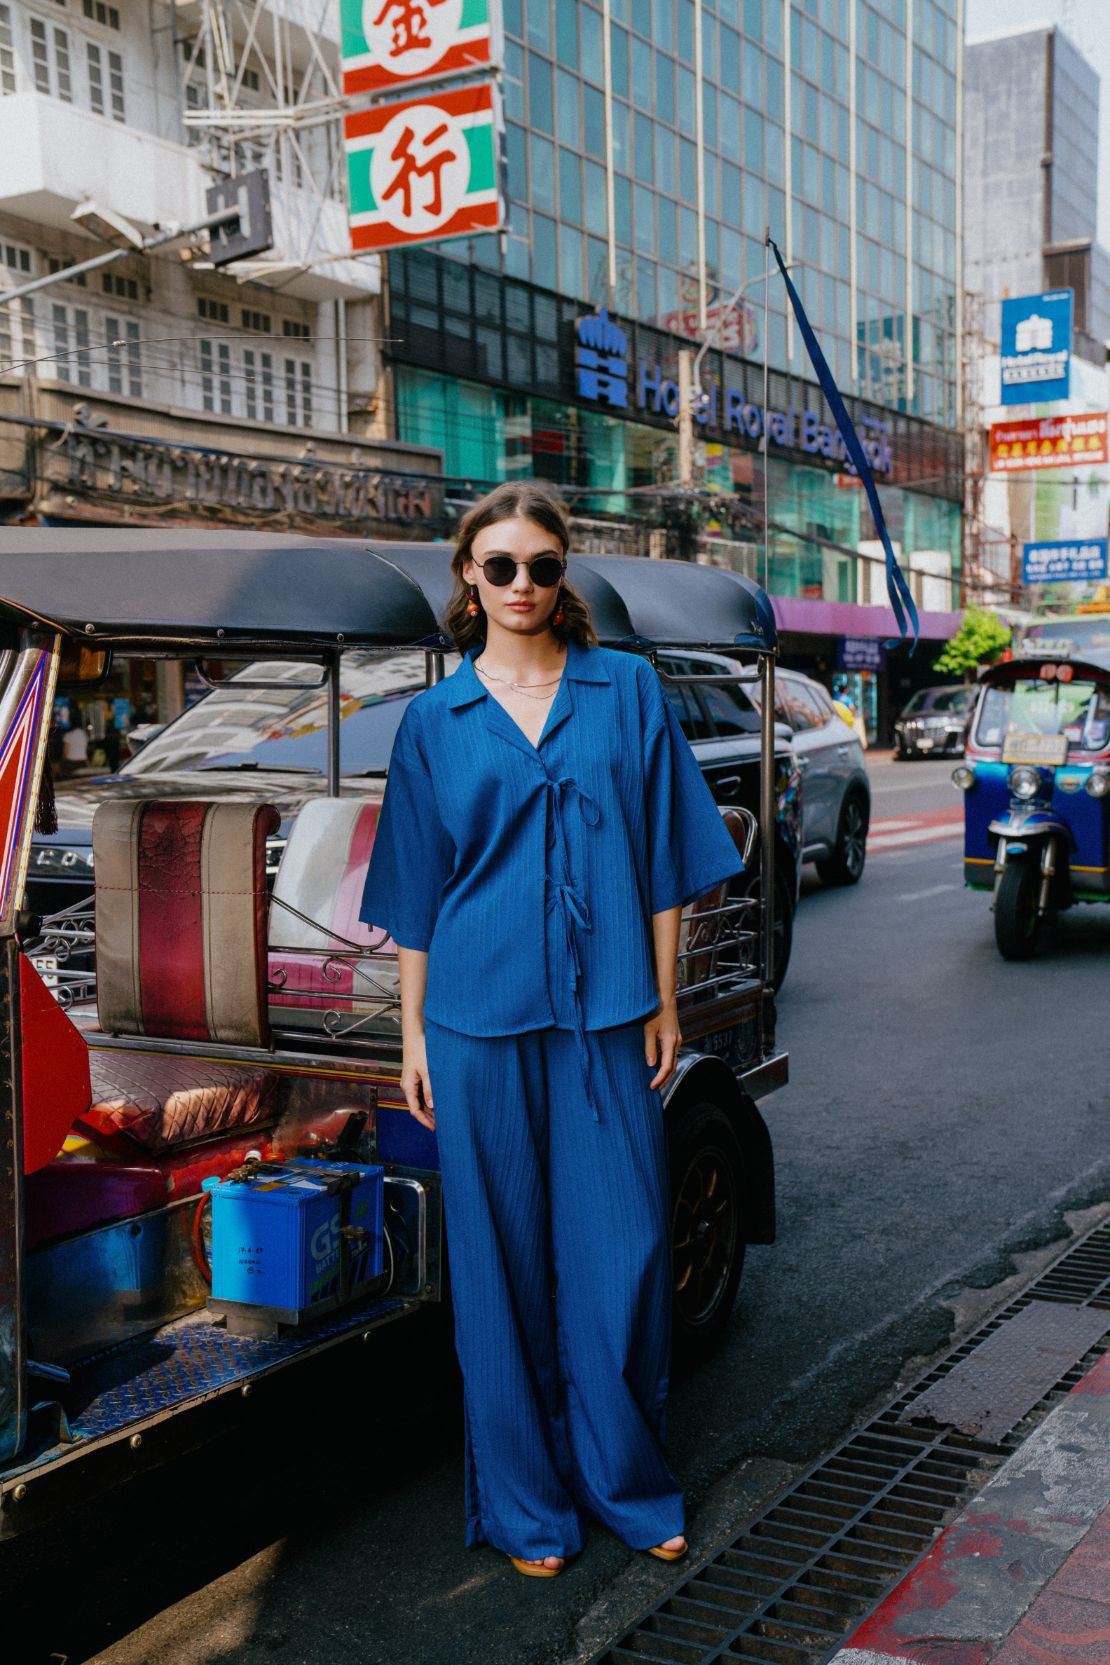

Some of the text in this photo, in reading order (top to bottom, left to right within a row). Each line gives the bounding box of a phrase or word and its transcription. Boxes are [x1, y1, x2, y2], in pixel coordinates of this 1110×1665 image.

[382, 123, 456, 217] 行
[640, 364, 718, 428] Hoel
[726, 387, 795, 449] Royal
